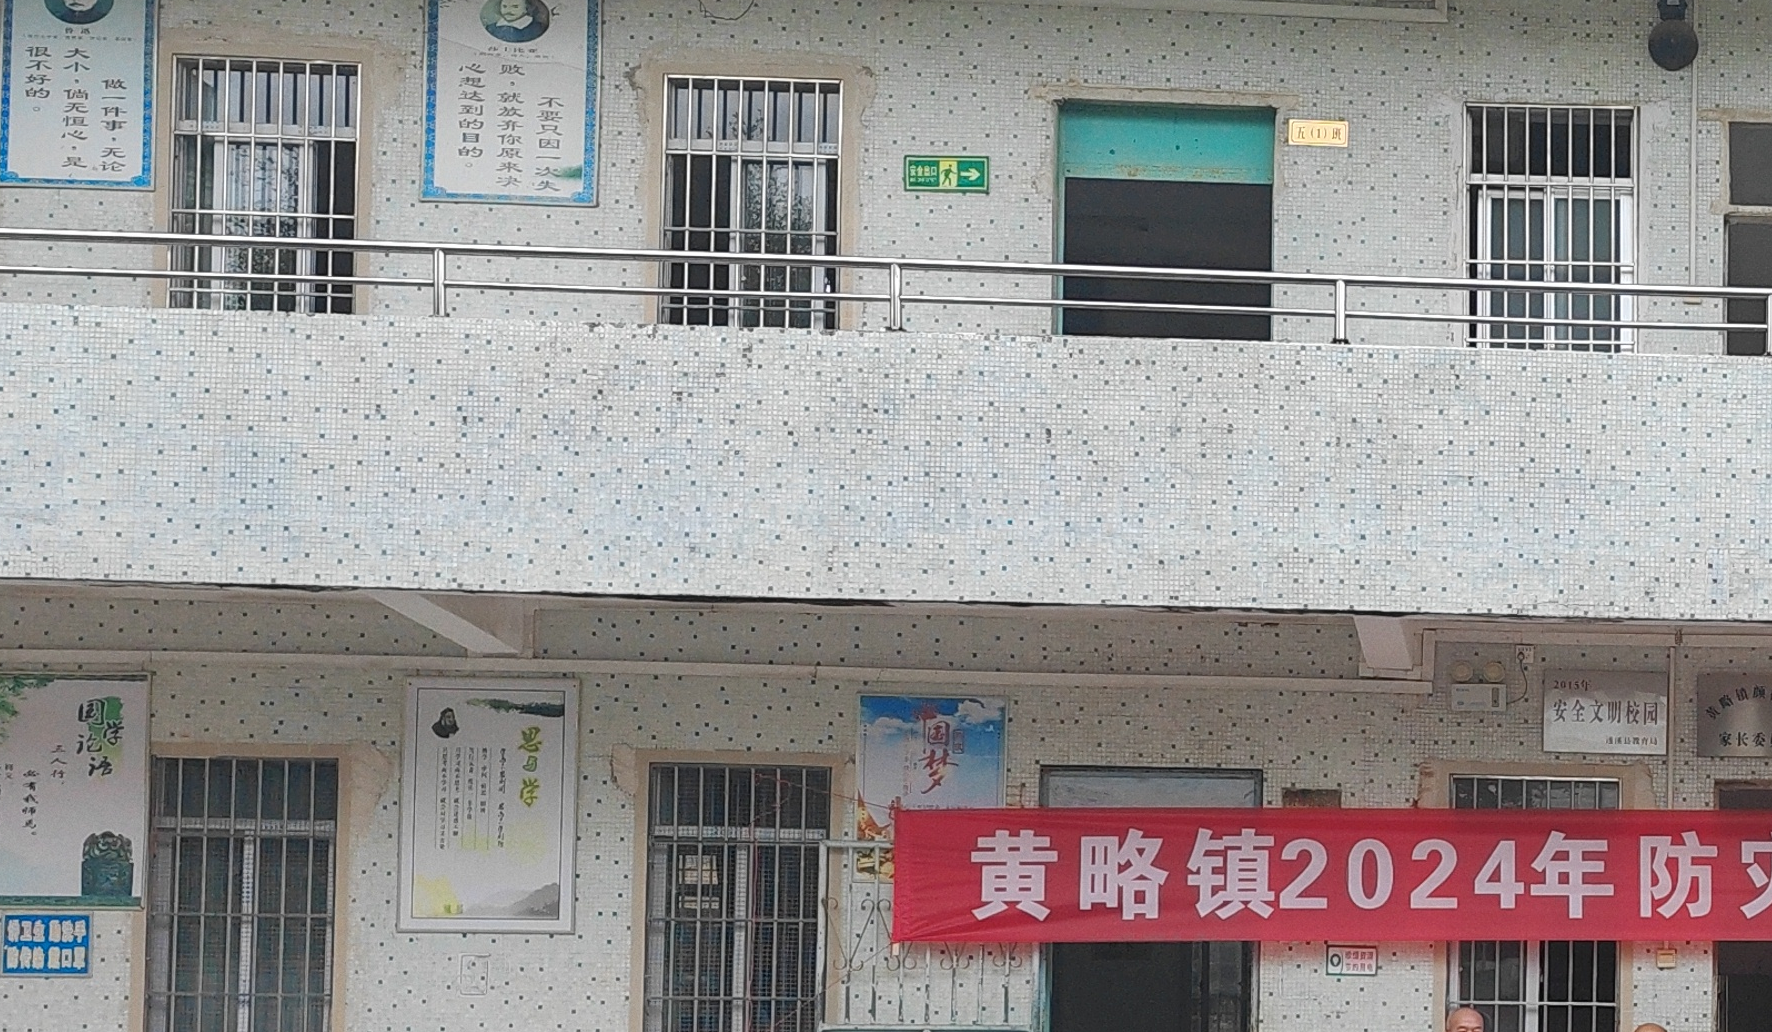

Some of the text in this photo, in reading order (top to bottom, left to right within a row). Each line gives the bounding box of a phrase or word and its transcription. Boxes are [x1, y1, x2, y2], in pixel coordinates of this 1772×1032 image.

[25, 46, 52, 112] 很不好的。
[458, 63, 486, 168] 心想达到的目的。
[99, 78, 128, 172] 做一件事，无论
[534, 96, 565, 192] 不要只因一次失
[1553, 679, 1592, 692] 2015年
[1553, 698, 1659, 726] 安全文明校园
[76, 699, 124, 777] 国学论语
